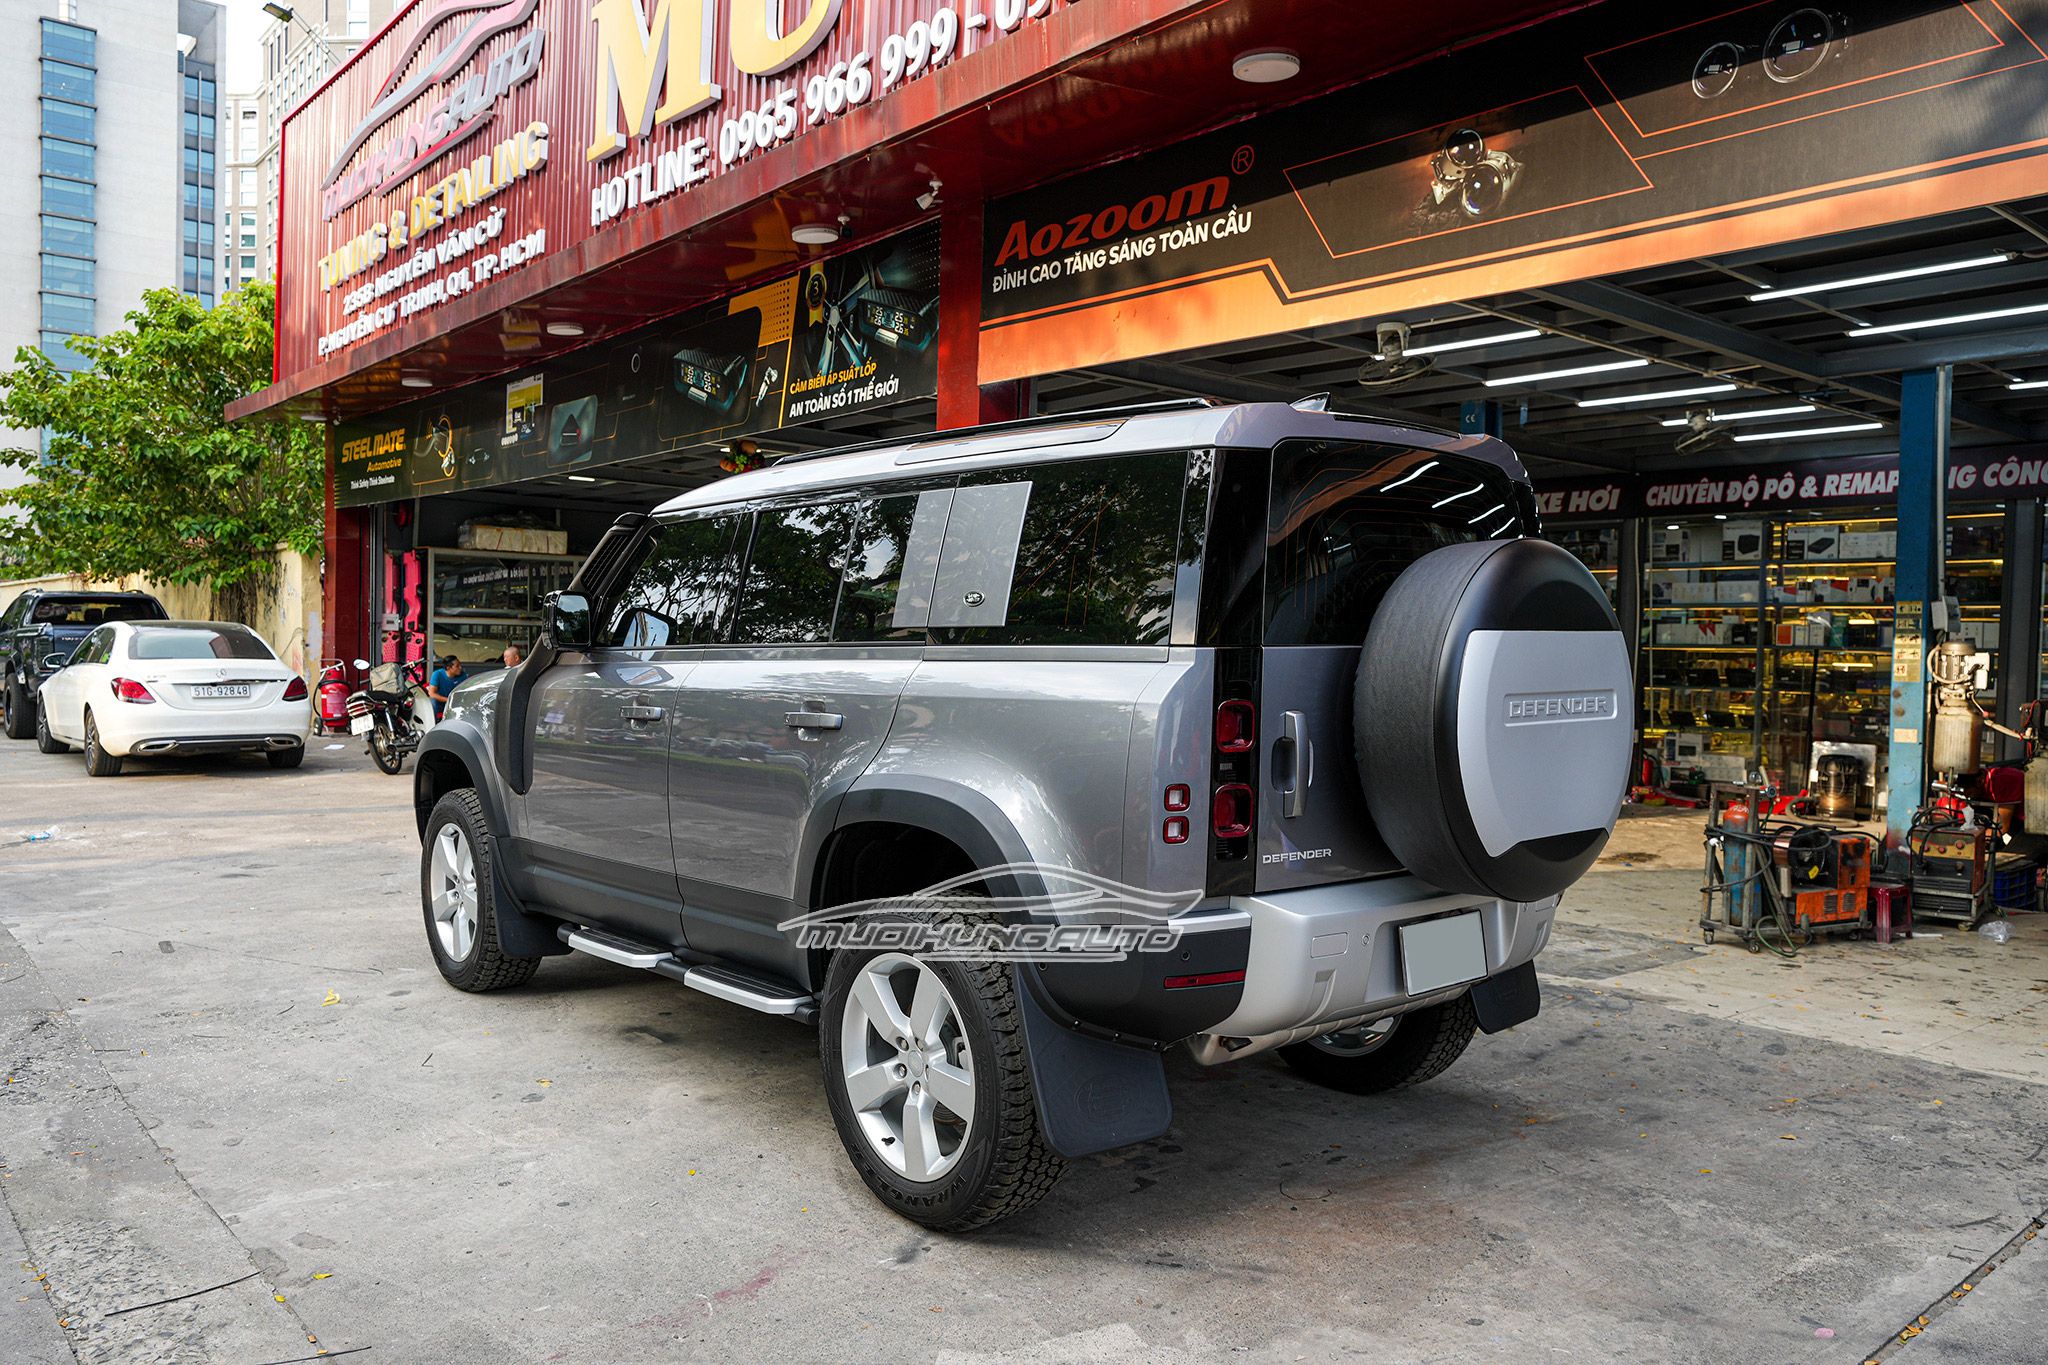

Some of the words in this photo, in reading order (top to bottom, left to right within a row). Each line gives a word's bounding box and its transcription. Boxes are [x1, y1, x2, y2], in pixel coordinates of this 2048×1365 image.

[591, 136, 710, 227] HOTLINE:
[719, 88, 797, 165] 0965
[806, 51, 872, 126] 966
[882, 7, 958, 89] 999
[318, 222, 388, 293] TUNING
[388, 210, 408, 250] &
[410, 121, 549, 240] DETAILING
[994, 176, 1230, 267] Aozoom
[993, 269, 1027, 293] ĐỈNH
[1030, 262, 1061, 285] CAO
[1064, 251, 1107, 276] TĂNG
[1109, 238, 1156, 265] SÁNG
[1159, 221, 1208, 250] TOÀN
[1212, 204, 1252, 240] CẦU
[789, 401, 803, 418] AN
[804, 392, 831, 414] TOÀN
[832, 383, 847, 408] SỐ
[853, 376, 874, 403] THẾ
[874, 374, 899, 398] GIỚI
[1568, 485, 1620, 512] HƠI
[1646, 478, 1724, 506] CHUYÊN
[1726, 474, 1759, 508] ĐỘ
[1763, 471, 1795, 500] PÔ
[1799, 475, 1818, 498] &
[1508, 696, 1607, 718] DEFENDER
[1262, 848, 1332, 864] DEFENDER
